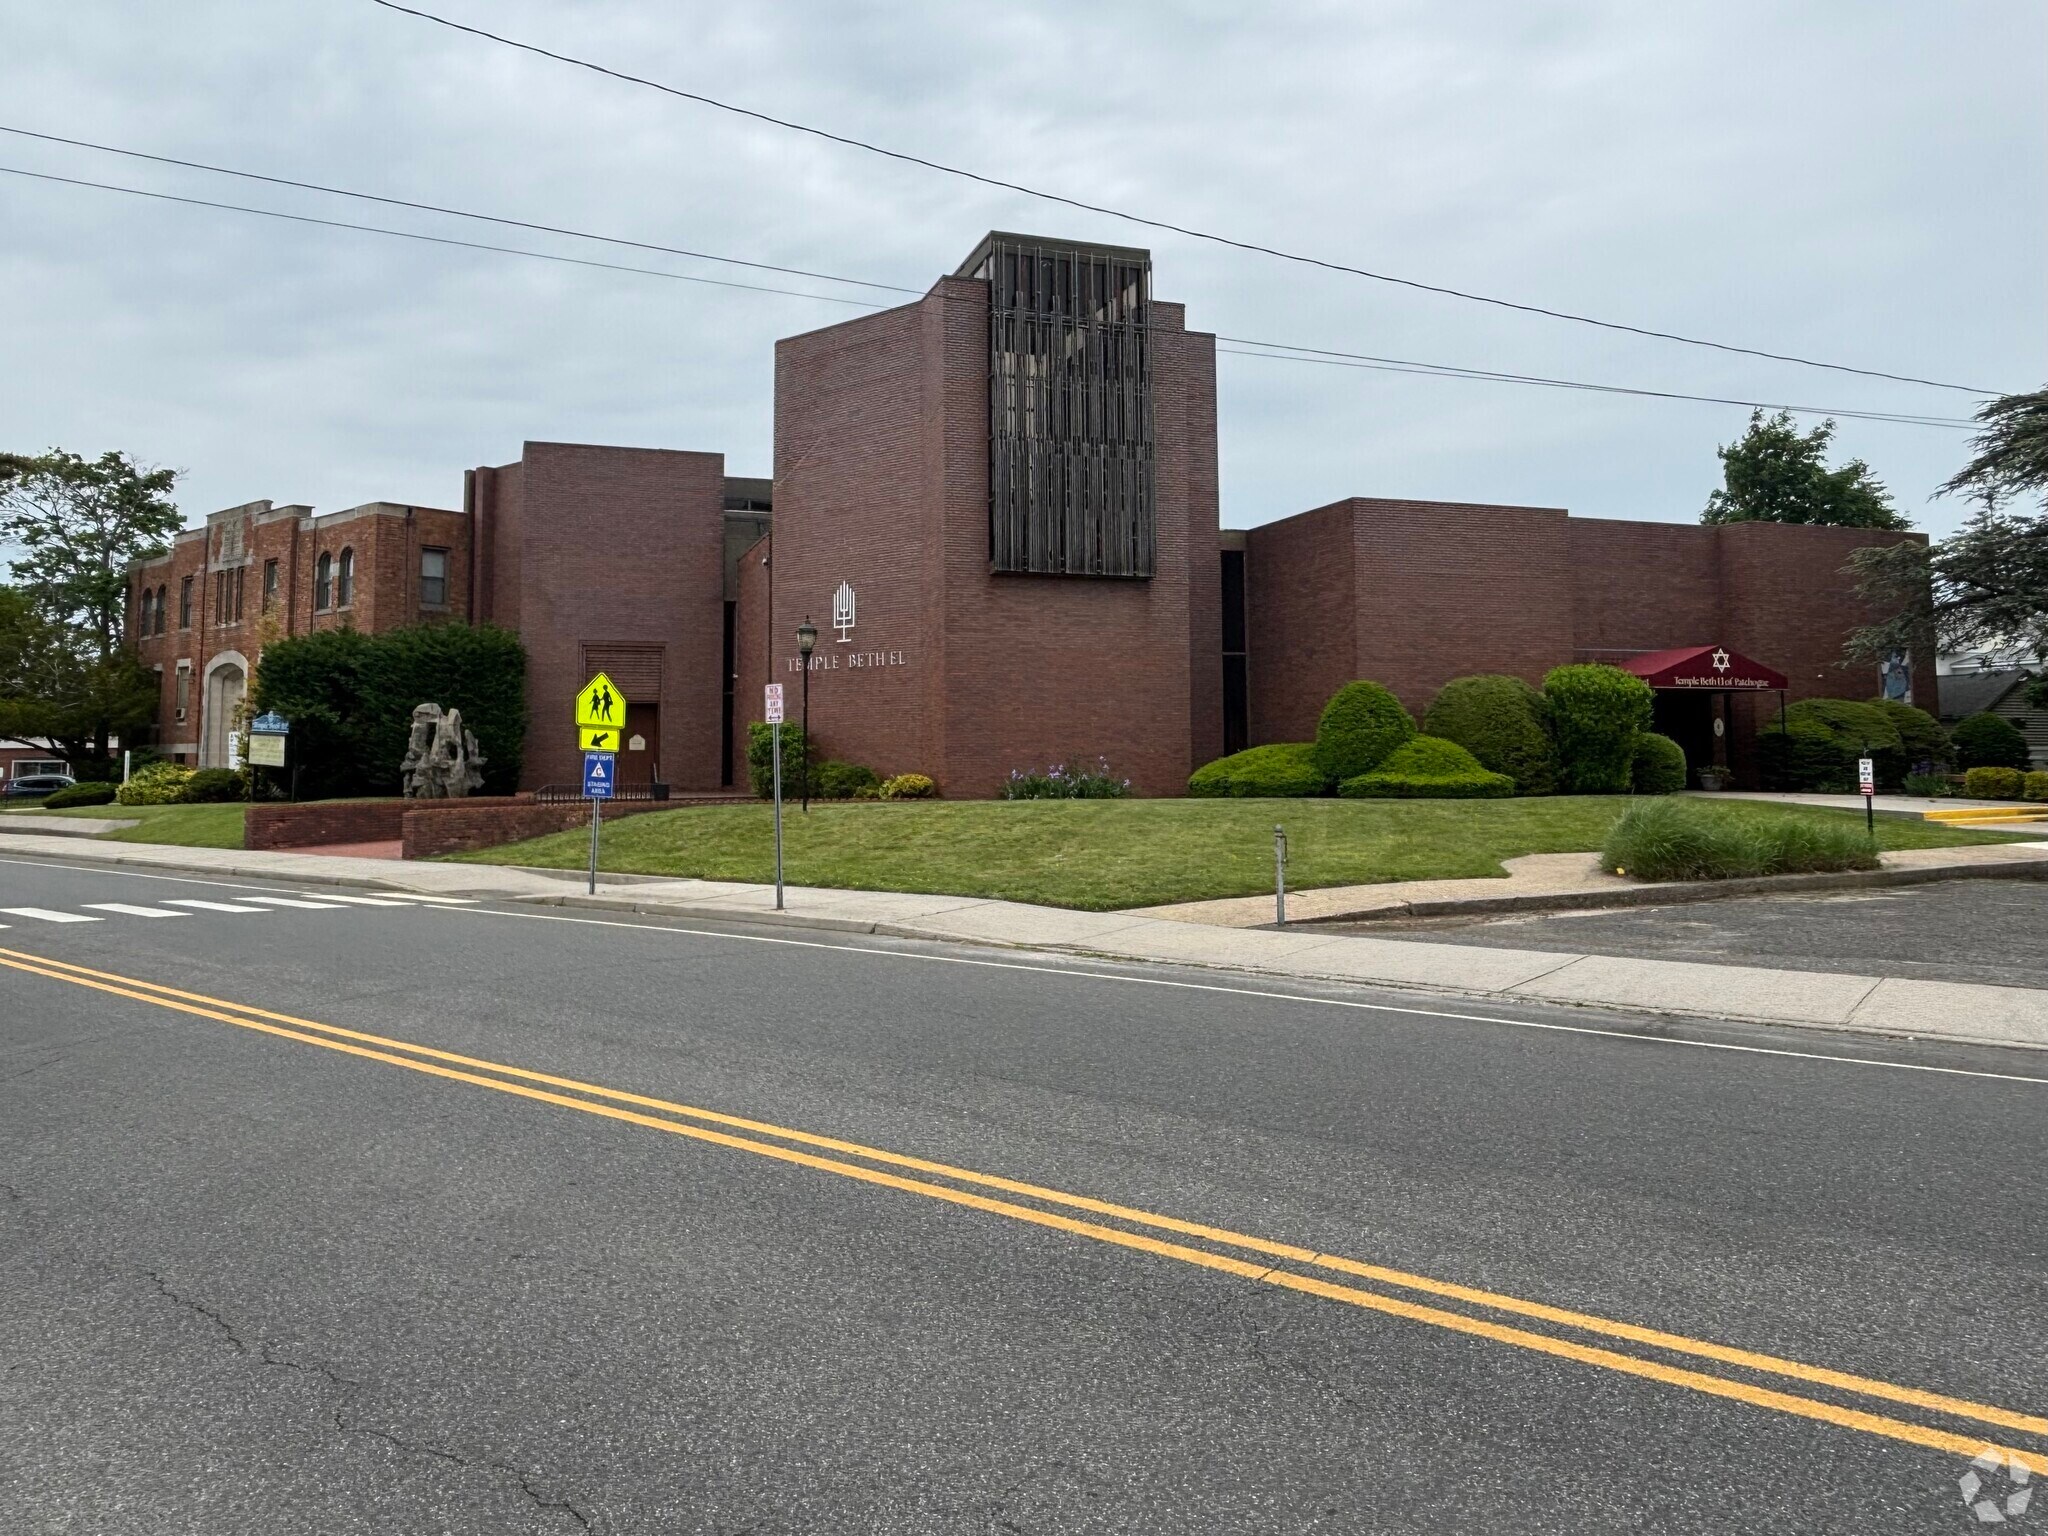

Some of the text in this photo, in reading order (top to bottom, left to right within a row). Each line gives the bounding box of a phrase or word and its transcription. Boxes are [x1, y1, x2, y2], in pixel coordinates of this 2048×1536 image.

[1674, 676, 1700, 688] Temple
[1700, 677, 1717, 686] Beth
[1725, 677, 1734, 686] of
[1735, 677, 1770, 689] Patchogue
